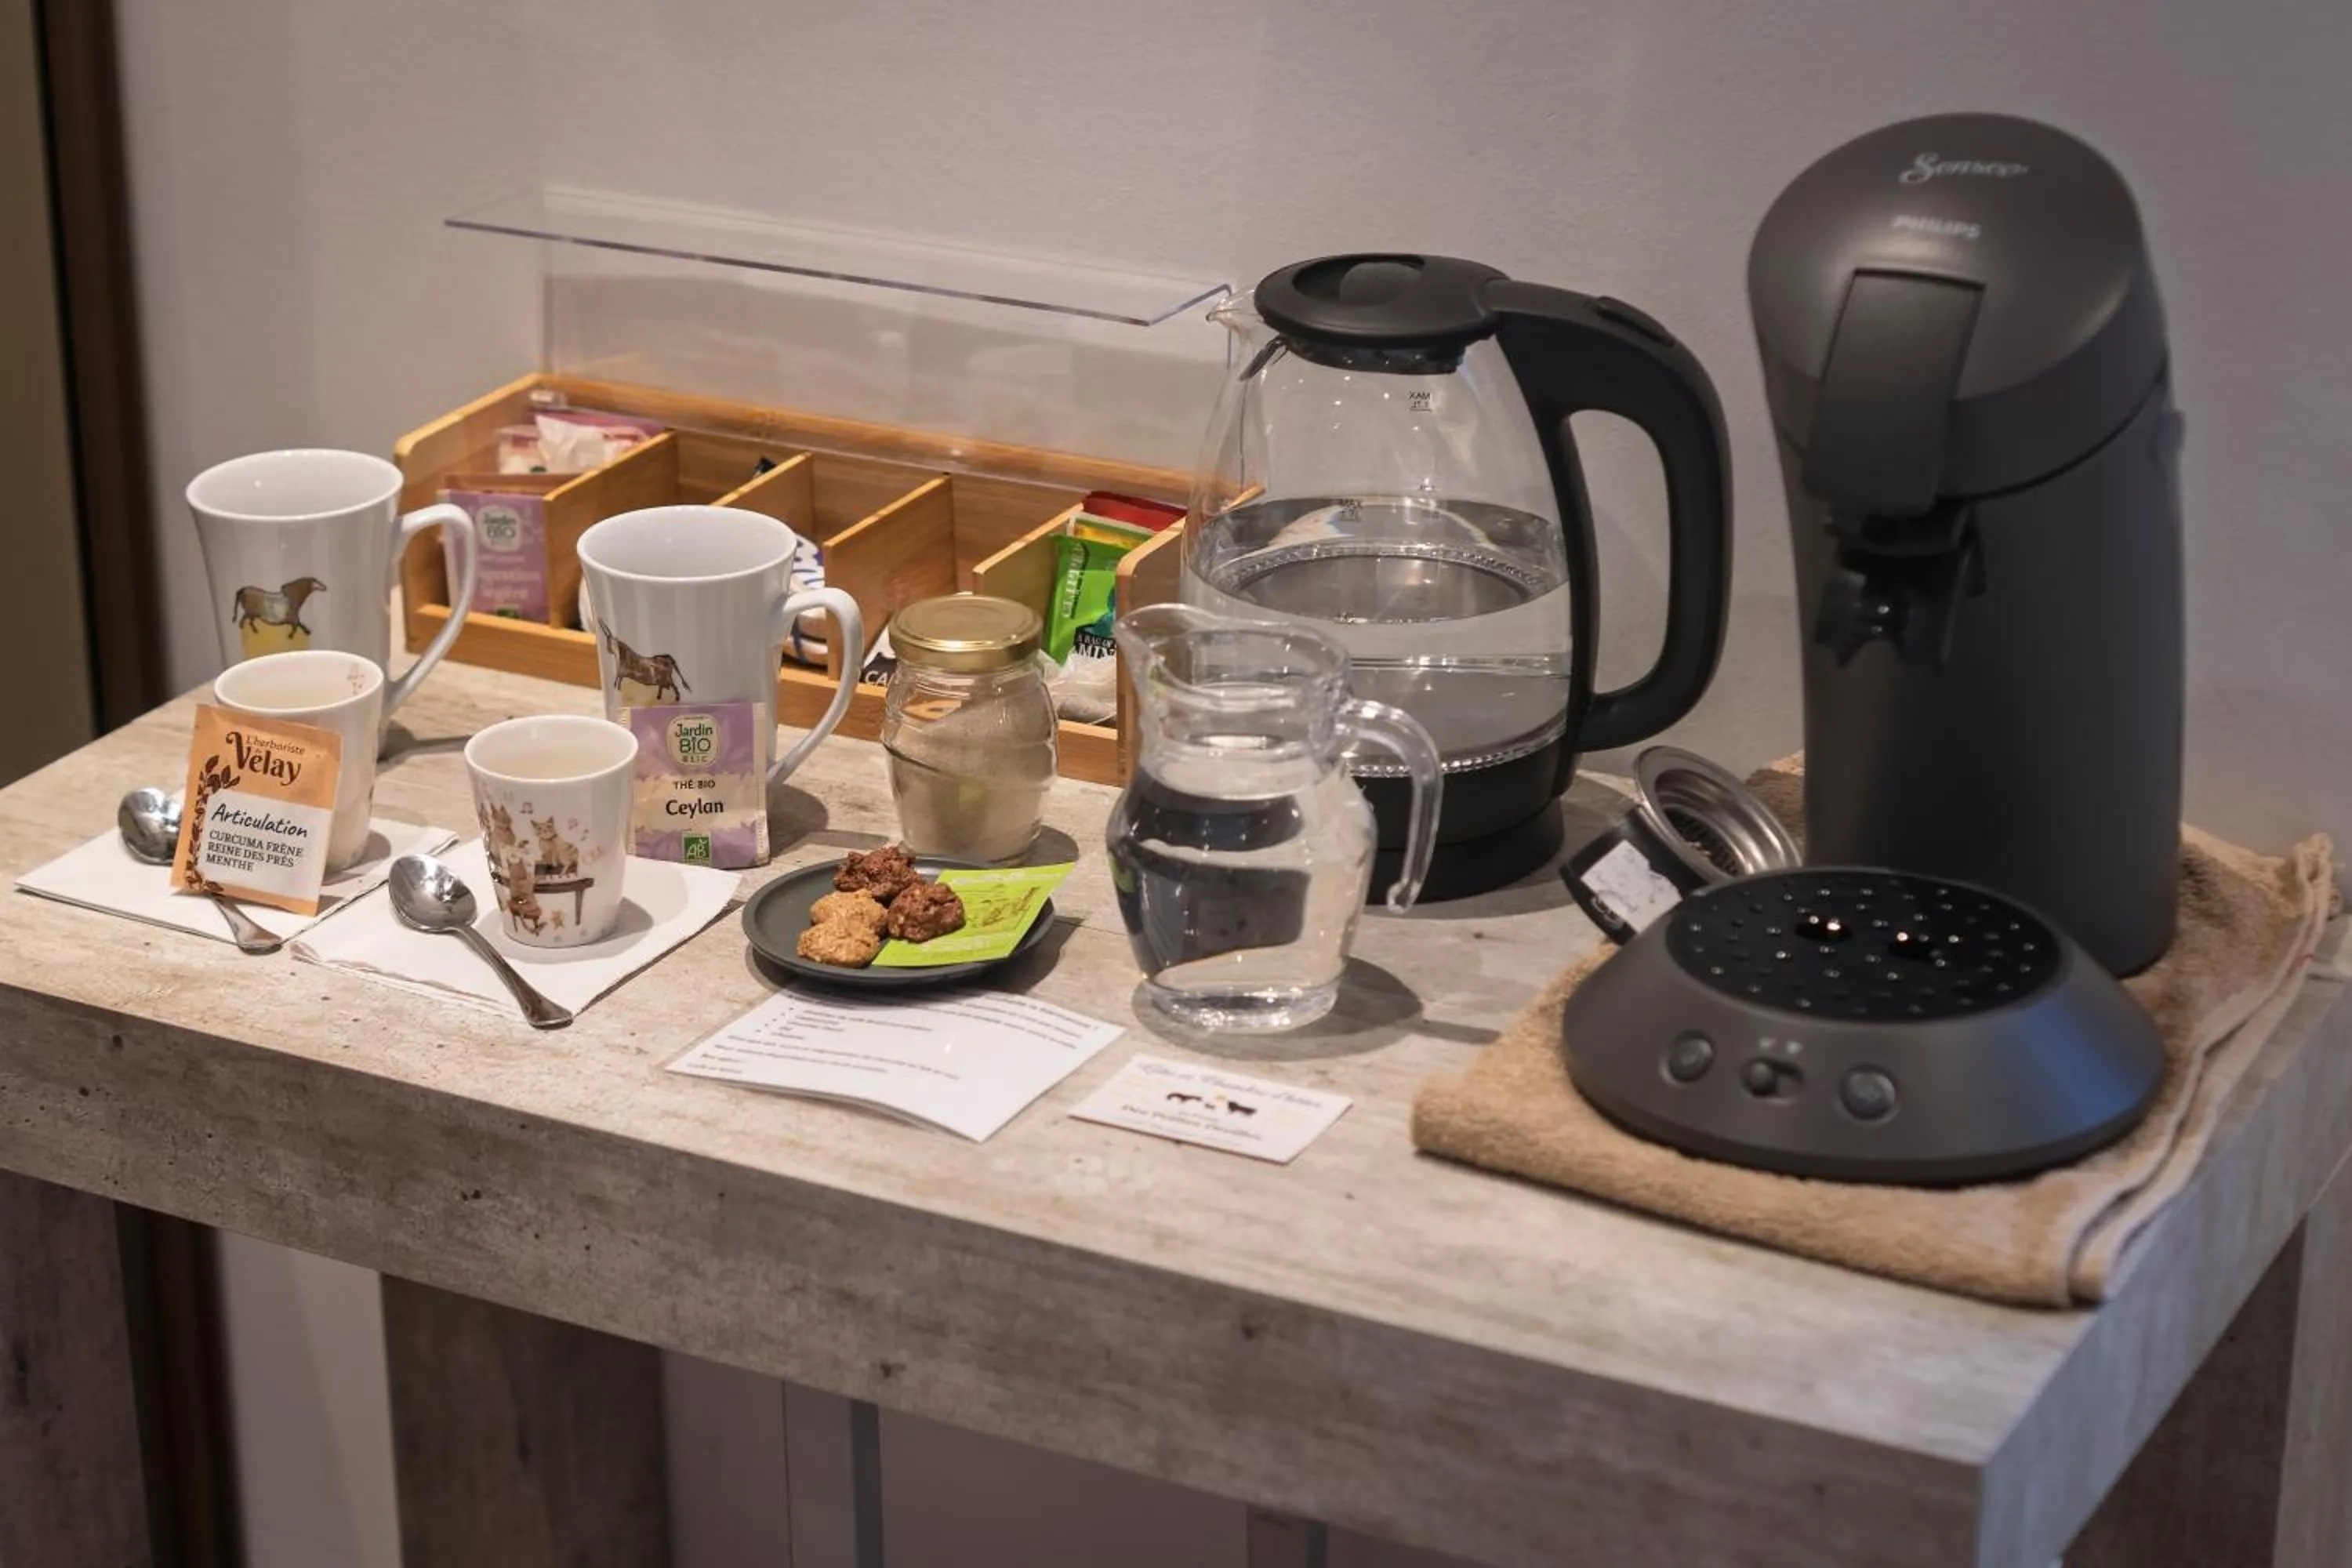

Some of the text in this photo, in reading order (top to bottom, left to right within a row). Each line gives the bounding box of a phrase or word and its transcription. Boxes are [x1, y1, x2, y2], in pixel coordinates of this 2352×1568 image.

[674, 723, 713, 737] Jardin
[225, 731, 302, 786] Velay
[673, 779, 716, 789] THÉ BIO
[666, 797, 724, 819] Ceylan
[211, 802, 307, 837] Articulation
[209, 829, 263, 850] CURCUMA
[205, 852, 254, 872] MENTHE
[208, 841, 242, 857] REINE
[243, 849, 264, 862] DES
